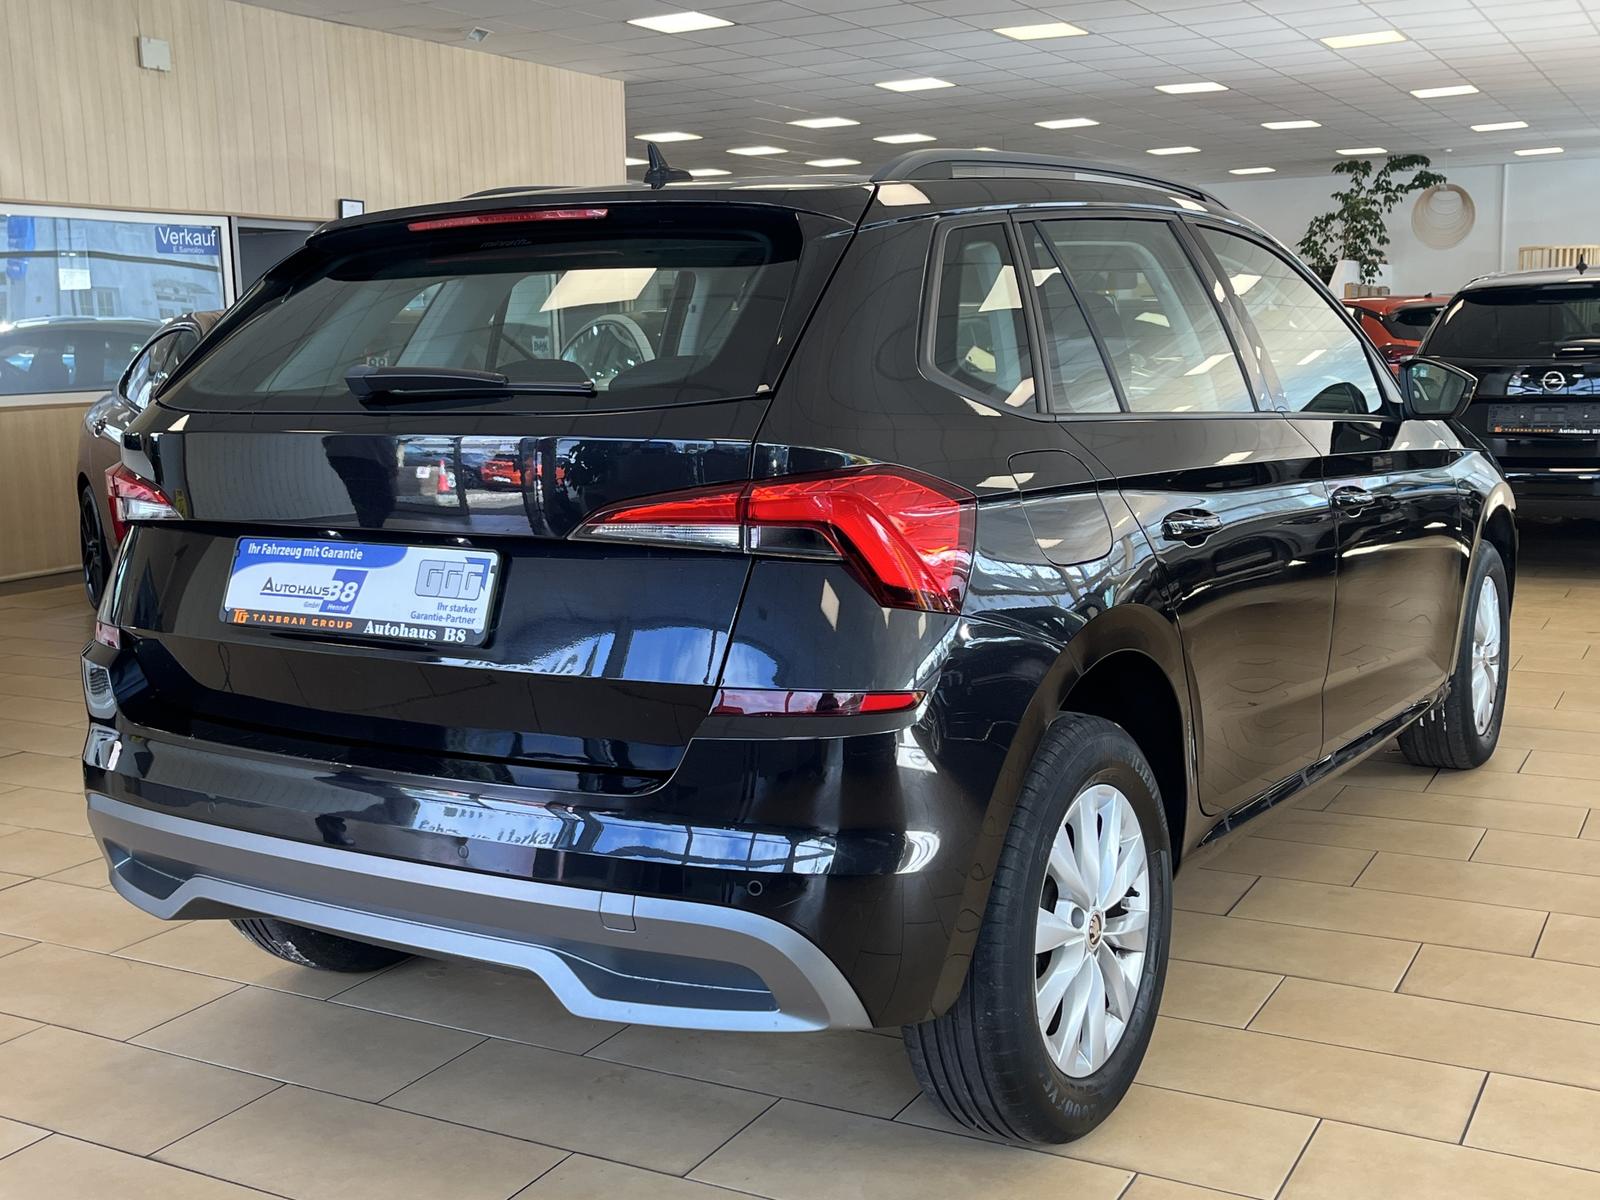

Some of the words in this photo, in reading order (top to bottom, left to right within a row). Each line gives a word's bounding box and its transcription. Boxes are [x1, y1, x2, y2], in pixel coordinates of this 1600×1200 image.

[158, 226, 216, 246] Verkauf
[248, 542, 261, 555] Ihr
[261, 543, 302, 560] Fahrzeug
[303, 545, 320, 558] mit
[320, 546, 363, 560] Garantie
[262, 576, 330, 597] AUTOHAUS
[436, 601, 449, 612] Ihr
[449, 603, 479, 614] starker
[311, 618, 354, 629] GROUP
[410, 610, 476, 625] Garantie-Partner
[363, 620, 438, 640] Autohaus
[443, 627, 467, 643] B8
